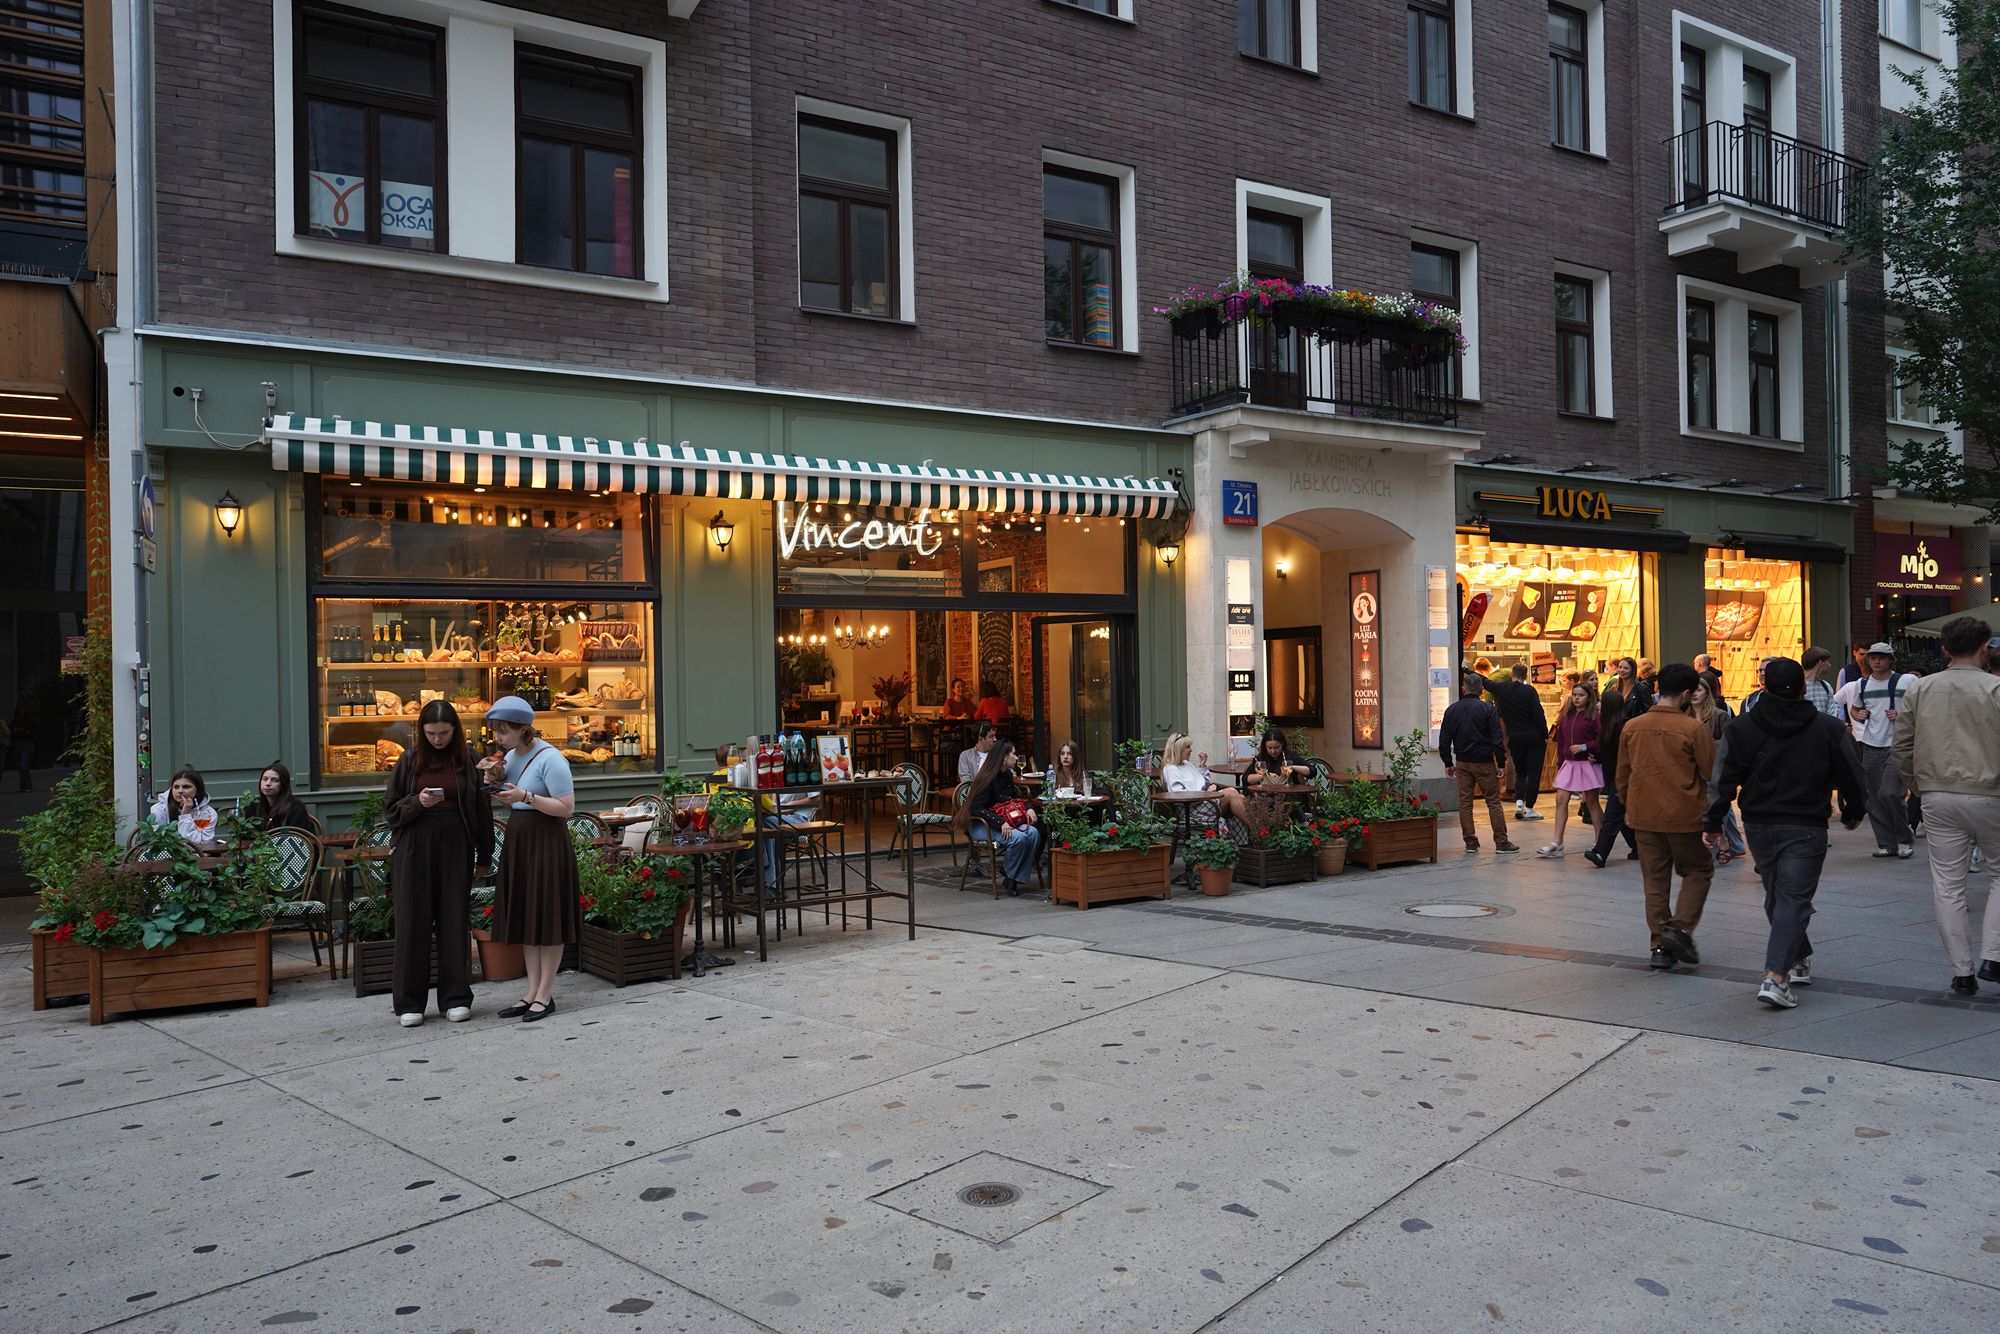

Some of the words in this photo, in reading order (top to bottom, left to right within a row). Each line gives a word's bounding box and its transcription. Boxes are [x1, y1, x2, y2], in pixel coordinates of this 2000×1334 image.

[1304, 449, 1375, 473] KAMIENICA
[1289, 471, 1392, 498] JABŁKOWSKICH
[1233, 491, 1251, 515] 21
[1542, 486, 1612, 520] LUCA
[778, 500, 943, 560] Vincent
[1354, 631, 1377, 640] MARIA
[1359, 624, 1371, 632] LUZ
[1354, 689, 1378, 697] COCINA
[1355, 698, 1378, 706] LATINA
